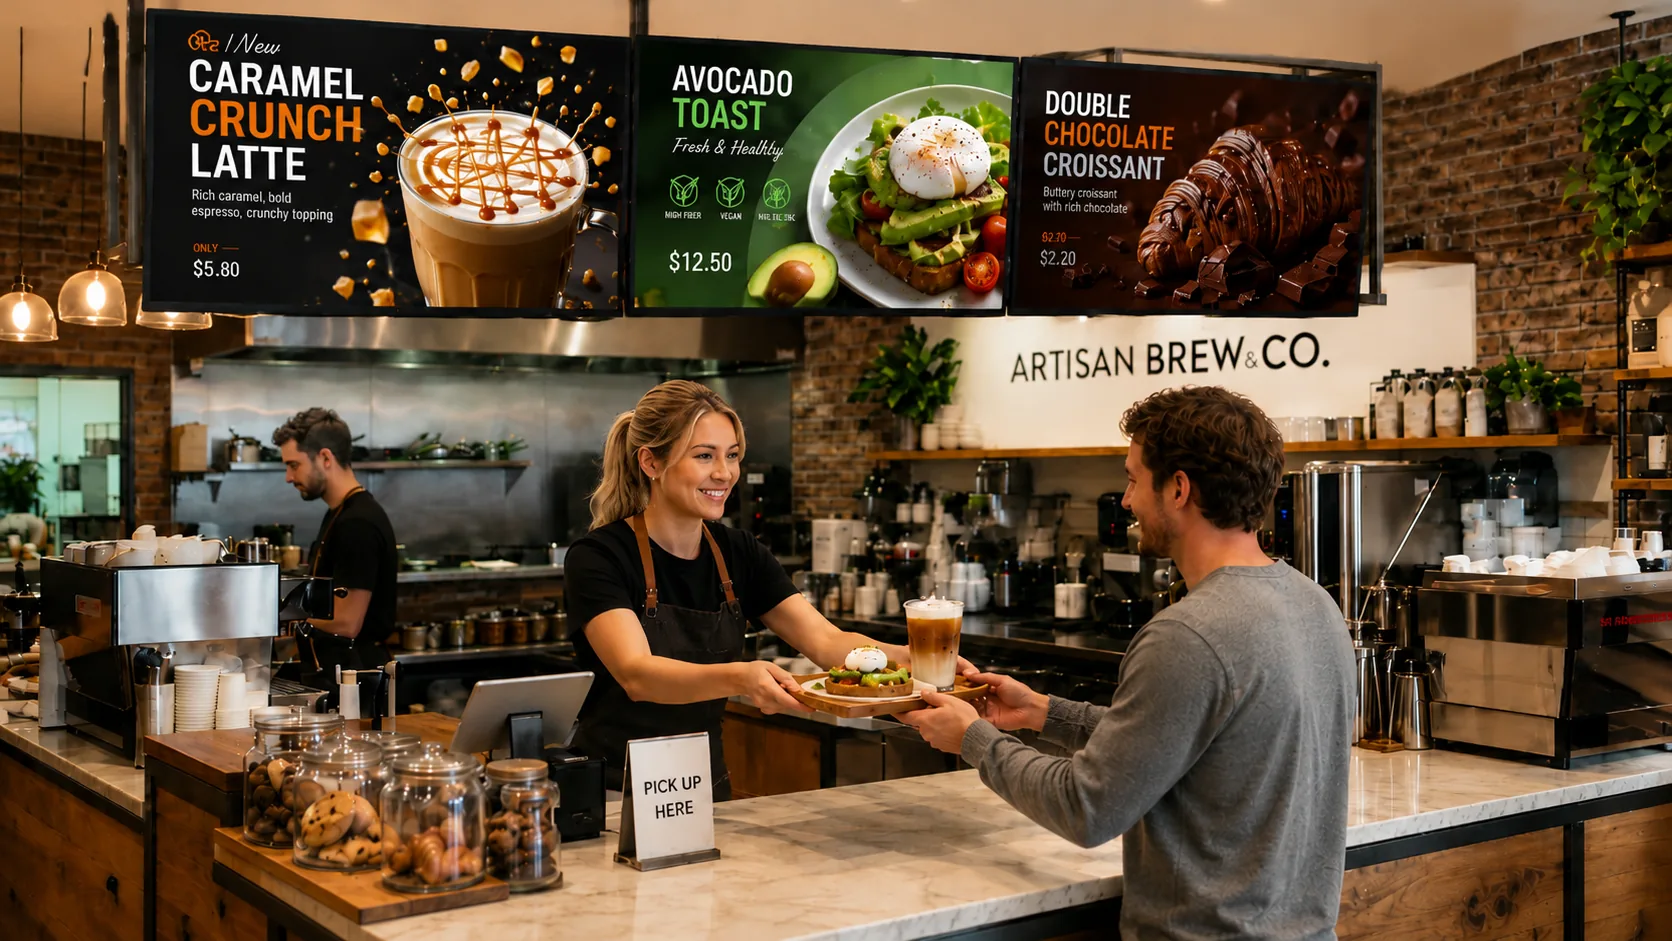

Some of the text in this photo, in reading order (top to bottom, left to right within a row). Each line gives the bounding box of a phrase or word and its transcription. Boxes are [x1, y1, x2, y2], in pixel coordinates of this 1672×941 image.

[189, 59, 364, 100] CARAMEL
[672, 65, 793, 97] AVOCADO
[672, 97, 767, 131] TOAST
[1045, 90, 1131, 118] DOUBLE
[190, 98, 361, 143] CRUNCH
[1044, 120, 1175, 150] CHOCOLATE
[672, 137, 710, 153] Fresh
[714, 138, 726, 154] &
[192, 143, 306, 181] LATTE
[1043, 151, 1165, 180] CROISSANT
[192, 189, 292, 204] Rich caramel, bold
[1043, 186, 1118, 200] Buttery croissant
[191, 207, 334, 223] espresso, crunchy topping
[720, 212, 742, 220] VEGAN
[1042, 200, 1128, 214] with rich chocolate
[193, 243, 219, 253] ONLY
[1040, 249, 1076, 267] $2.20
[193, 258, 240, 278] $5.80
[669, 249, 732, 273] $12.50
[1010, 331, 1330, 383] ARTISAN BREW & CO.
[644, 775, 702, 795] PICK UP
[655, 800, 694, 819] HERE
